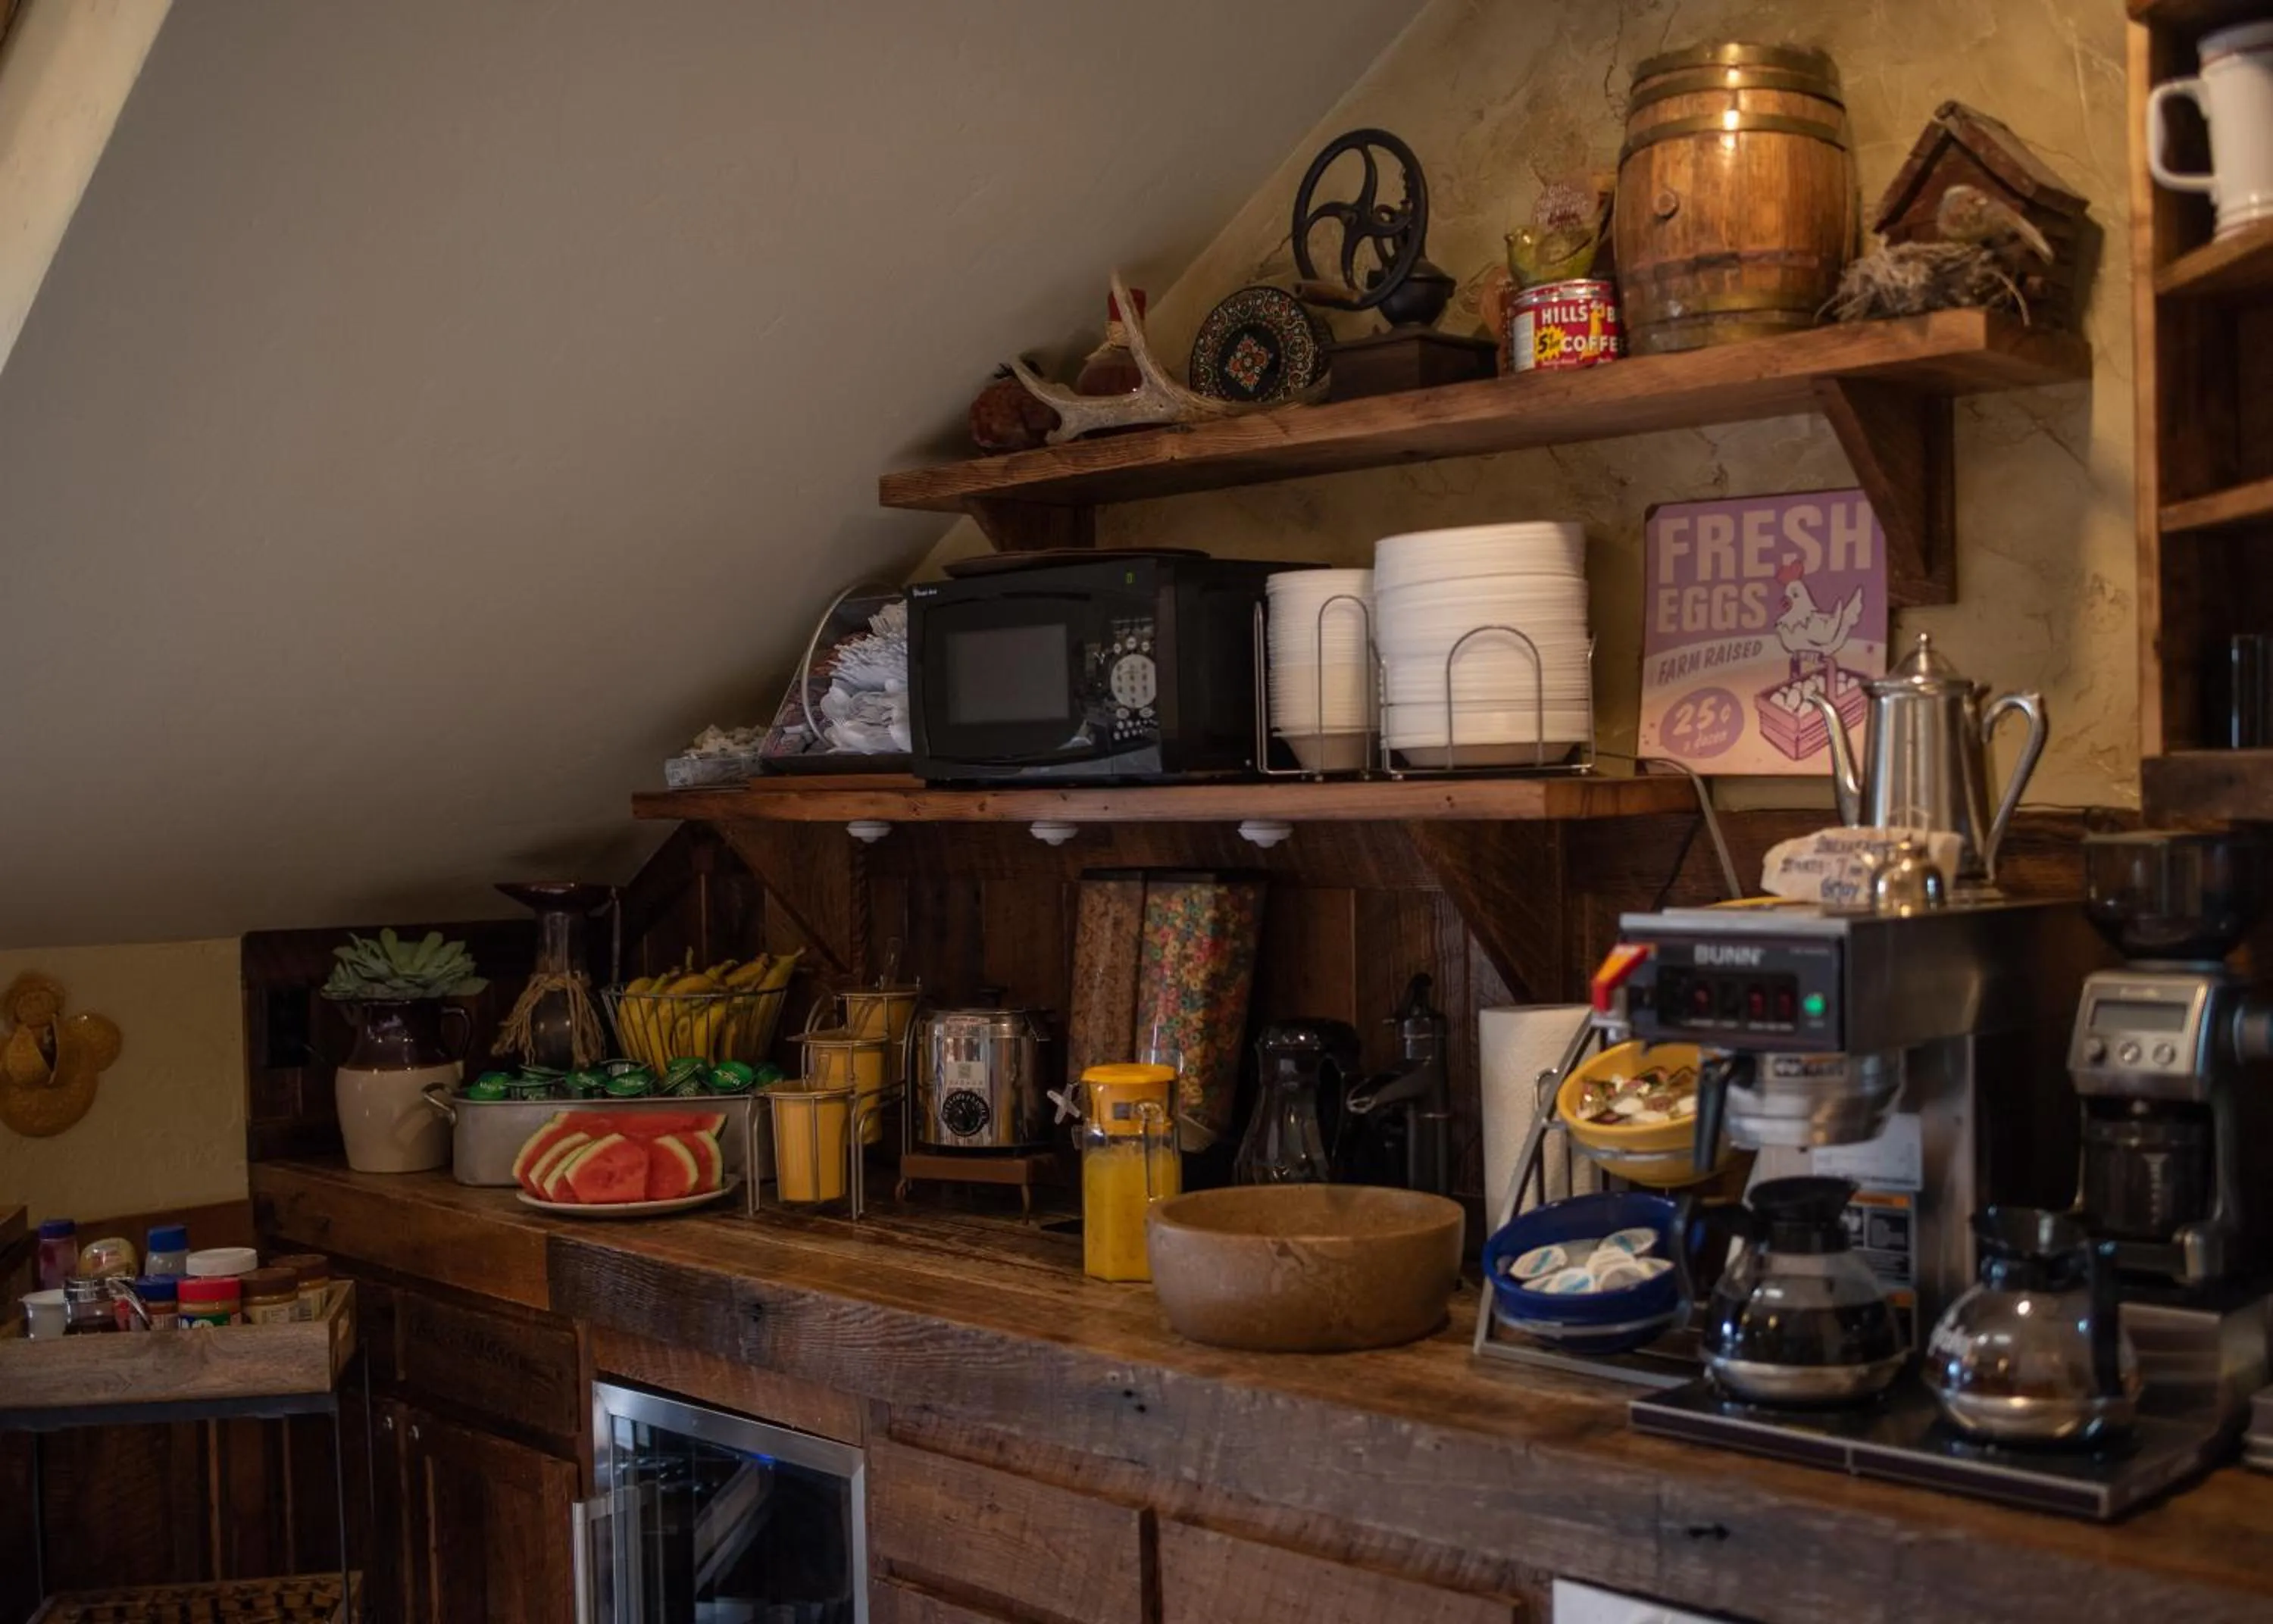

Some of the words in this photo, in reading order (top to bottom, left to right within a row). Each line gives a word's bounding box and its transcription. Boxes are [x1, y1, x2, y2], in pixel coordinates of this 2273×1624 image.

[1541, 304, 1589, 326] HILLS
[1659, 500, 1873, 585] FRESH
[1656, 582, 1768, 633] EGGS
[1658, 649, 1702, 685] FARM
[1704, 639, 1764, 669] RAISED
[1694, 944, 1762, 967] BUNN
